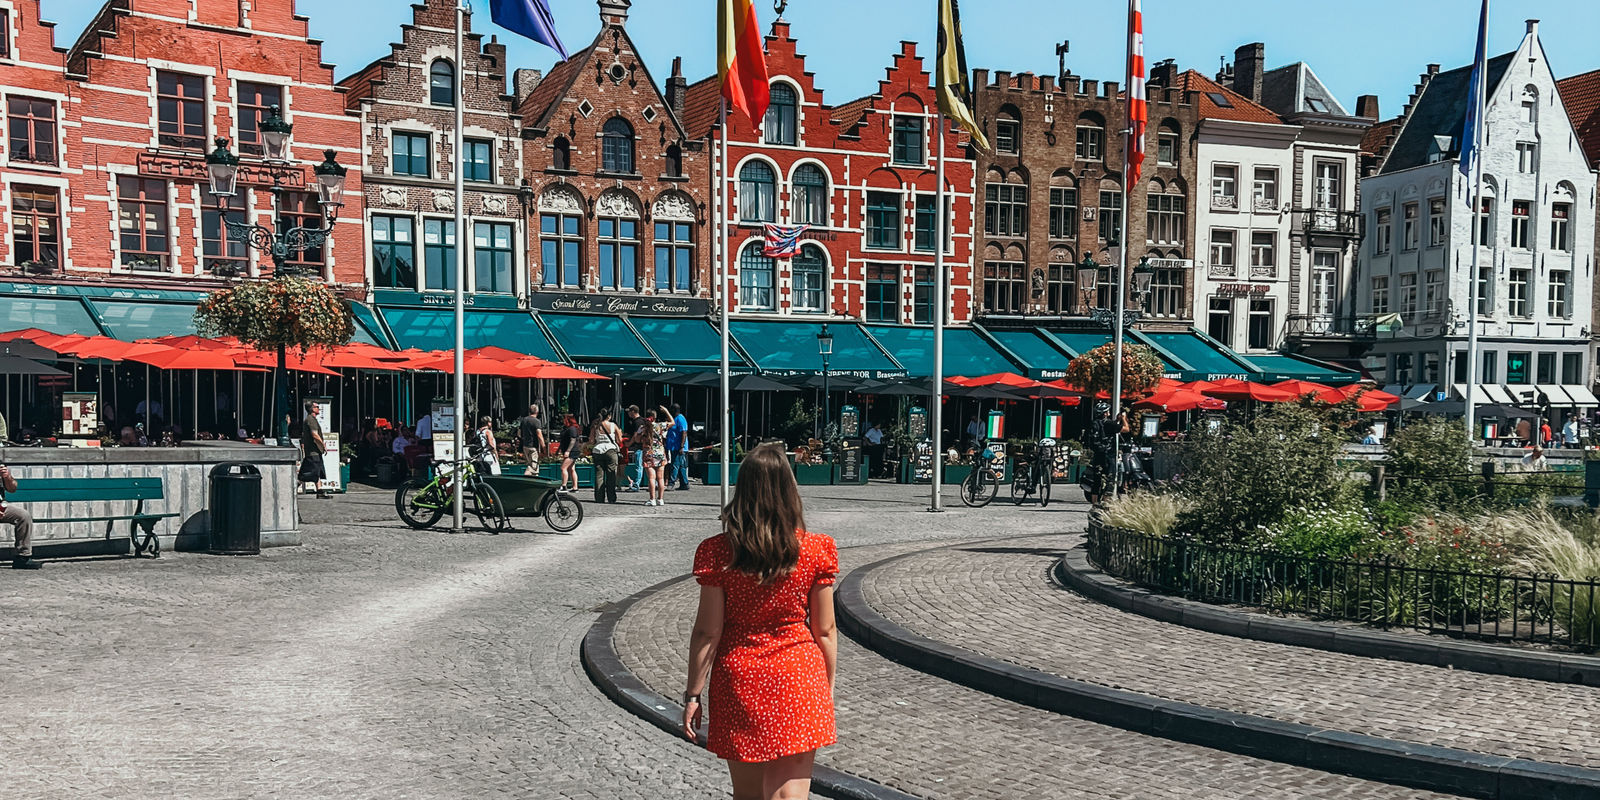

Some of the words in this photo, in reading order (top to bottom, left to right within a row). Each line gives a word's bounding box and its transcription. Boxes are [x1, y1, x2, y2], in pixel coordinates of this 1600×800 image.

[423, 295, 445, 305] SINT
[447, 296, 475, 306] JRIS
[551, 298, 576, 310] Grand
[606, 296, 639, 312] Central
[651, 302, 690, 313] Brasserie
[578, 366, 598, 374] Hotel
[1207, 373, 1228, 382] PETIT
